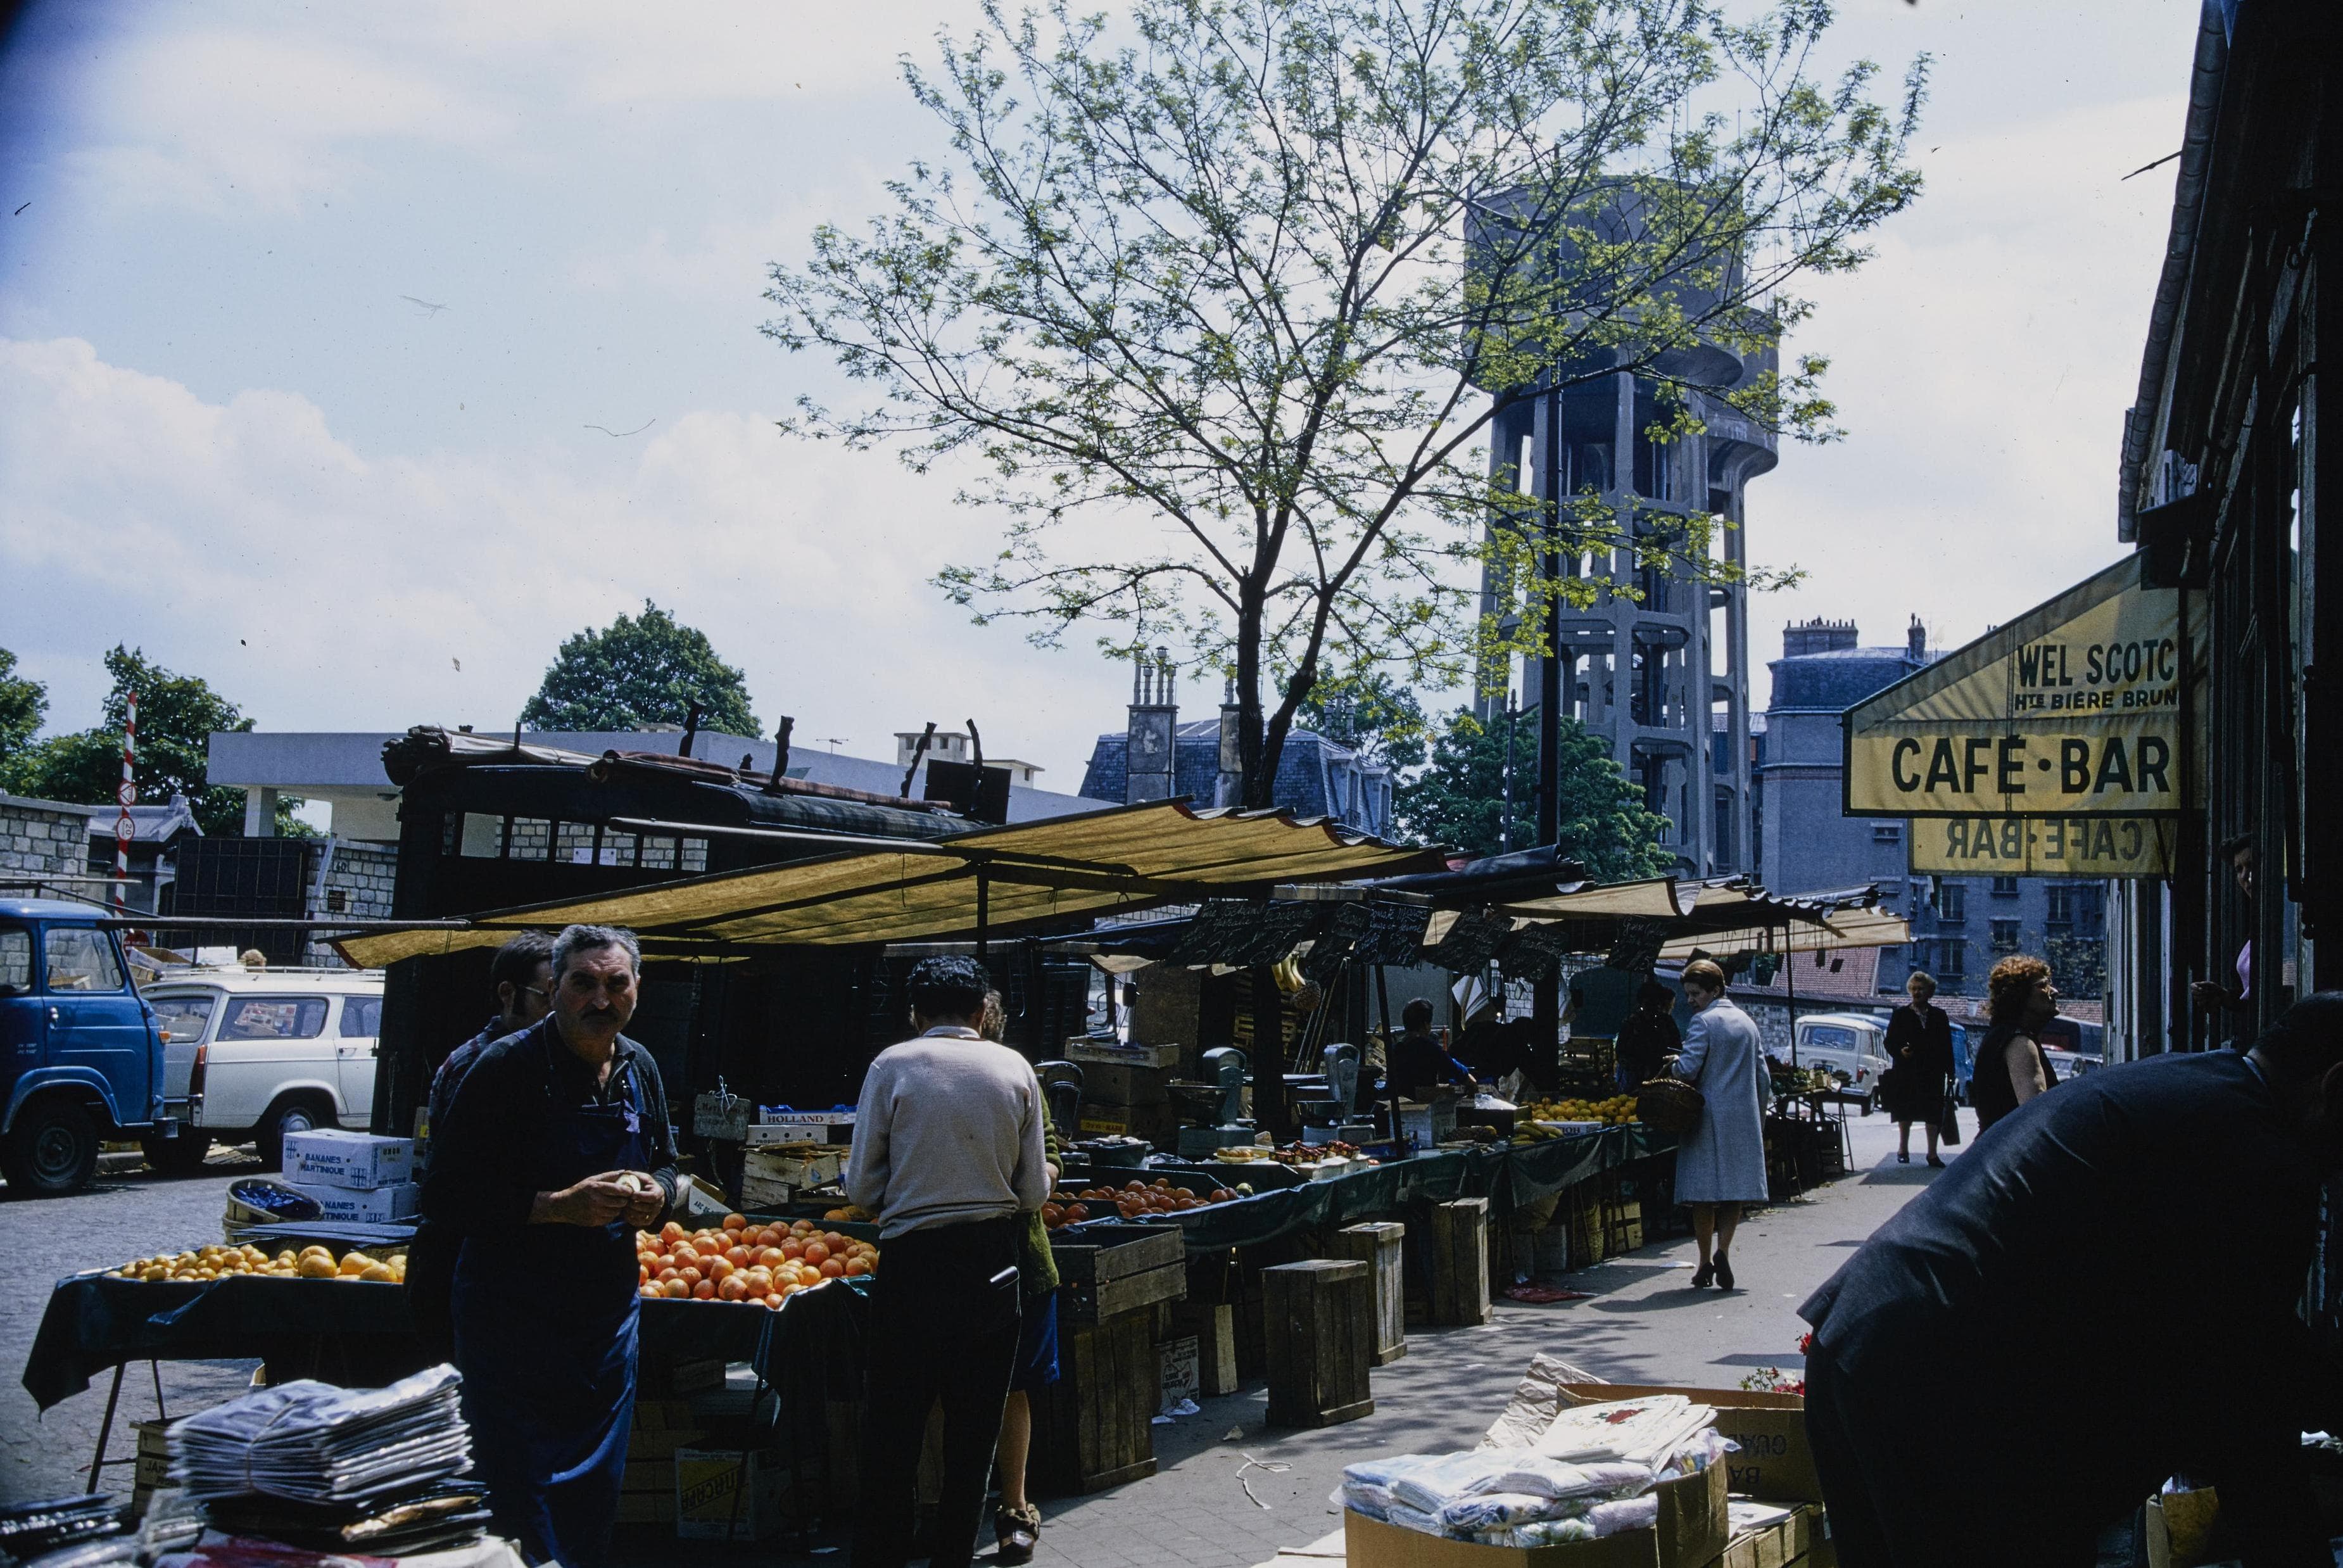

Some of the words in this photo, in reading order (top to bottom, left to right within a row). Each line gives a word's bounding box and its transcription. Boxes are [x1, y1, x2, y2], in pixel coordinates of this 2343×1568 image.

[2018, 644, 2073, 687] WEL
[2123, 688, 2179, 707] BRUN
[2060, 735, 2171, 794] BAR
[767, 1115, 824, 1123] HOLLAND
[305, 1153, 341, 1164] BANANES
[300, 1164, 344, 1175] MARTINIQUE
[322, 1201, 355, 1210] NANES
[323, 1212, 358, 1221] TINIQUE
